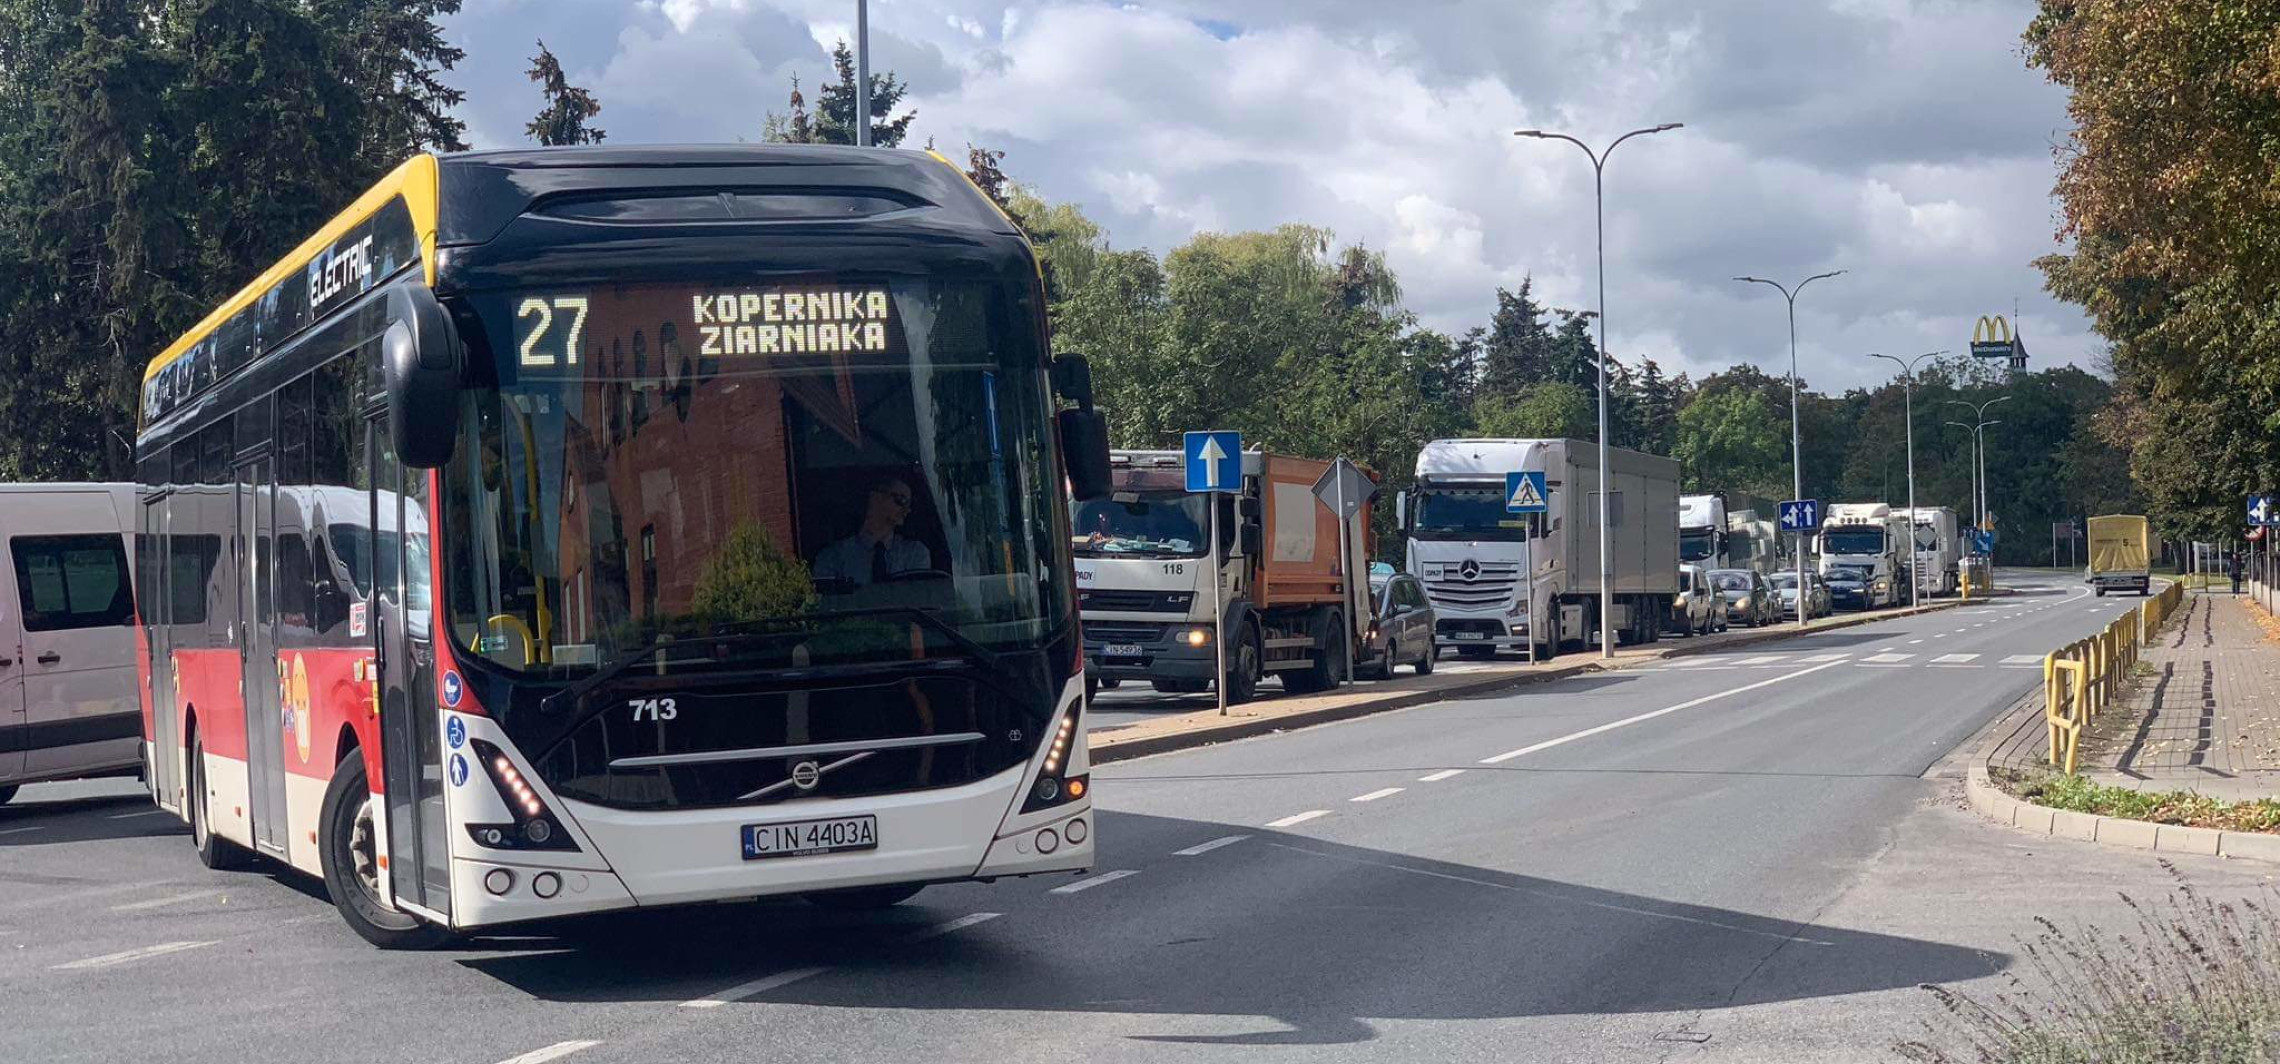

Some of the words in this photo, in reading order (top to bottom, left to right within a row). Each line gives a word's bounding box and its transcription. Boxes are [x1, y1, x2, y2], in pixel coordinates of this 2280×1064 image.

[310, 235, 373, 307] ELECTRIC
[693, 291, 887, 323] KOPERNIKA
[517, 297, 588, 366] 27
[700, 322, 885, 355] ZIARNIAKA
[1074, 571, 1093, 581] PADY
[1163, 563, 1184, 575] 118
[628, 698, 678, 721] 713
[756, 826, 799, 851] CIN
[806, 820, 873, 847] 4403A
